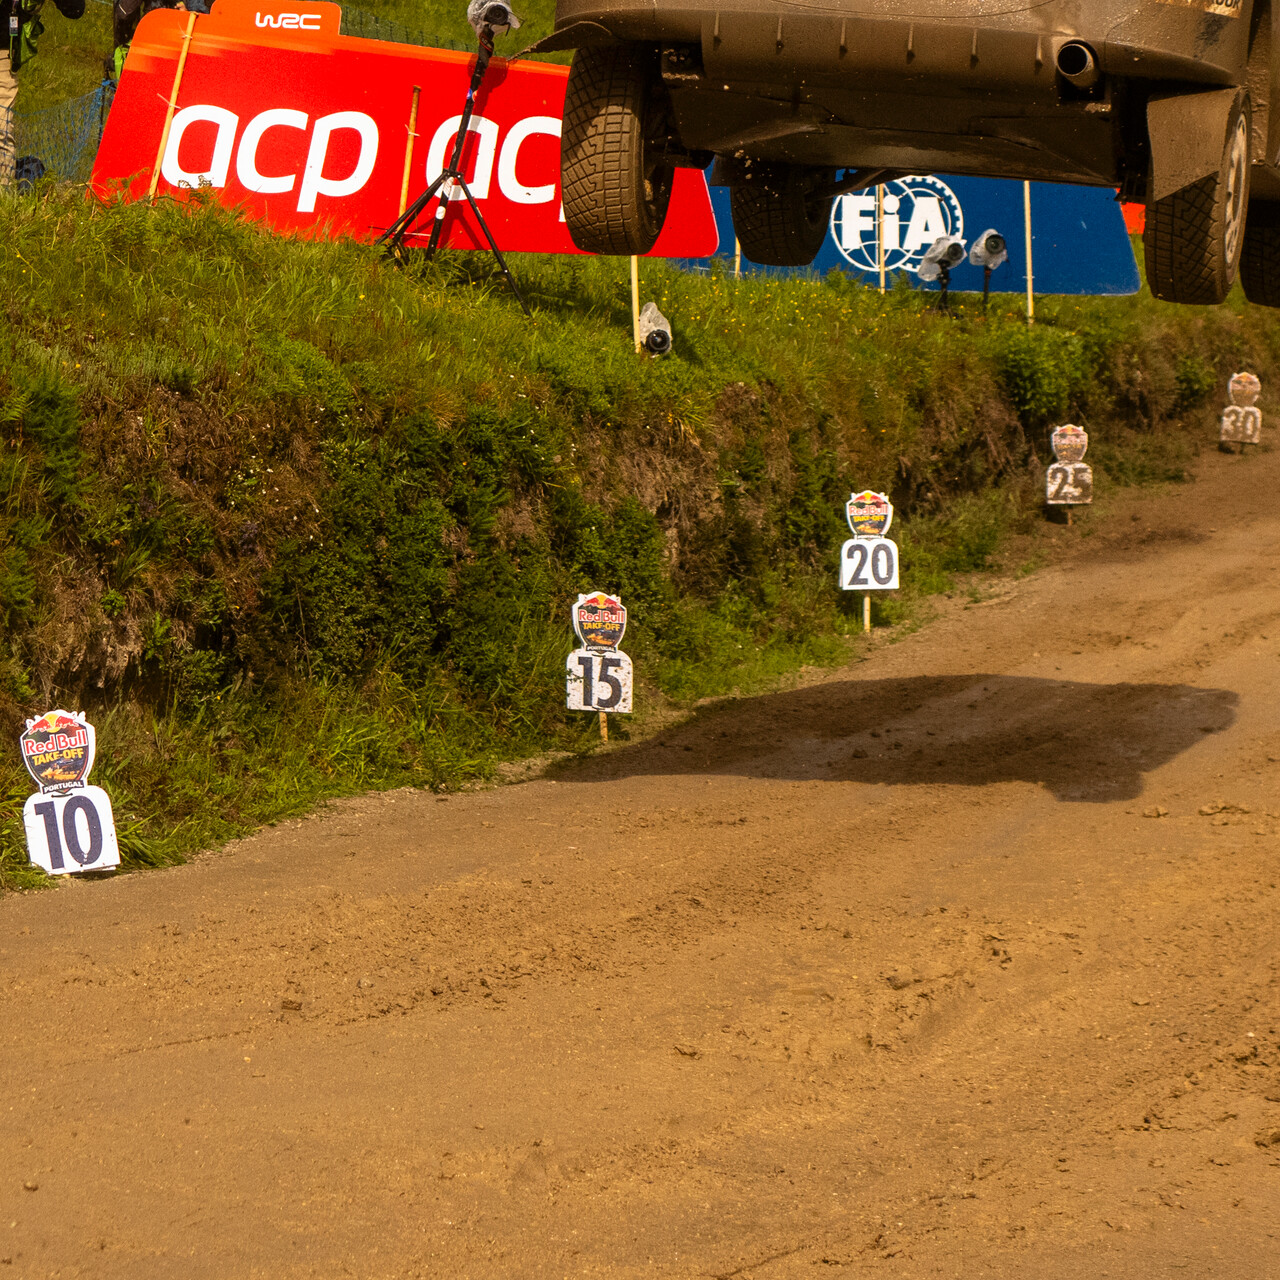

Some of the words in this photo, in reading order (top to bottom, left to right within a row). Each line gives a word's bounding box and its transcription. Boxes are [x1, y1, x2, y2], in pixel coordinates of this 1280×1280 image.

[255, 12, 322, 30] WRC
[161, 103, 380, 212] acp
[426, 114, 565, 223] ac
[1050, 466, 1092, 501] 25
[846, 543, 894, 586] 20
[579, 609, 601, 622] Red
[602, 610, 625, 623] Bull
[578, 656, 623, 708] 15
[24, 735, 57, 756] Red
[57, 730, 88, 750] Bull
[31, 748, 84, 767] TAKE-OFF
[43, 781, 84, 793] PORTUGAL
[34, 795, 103, 870] 10
